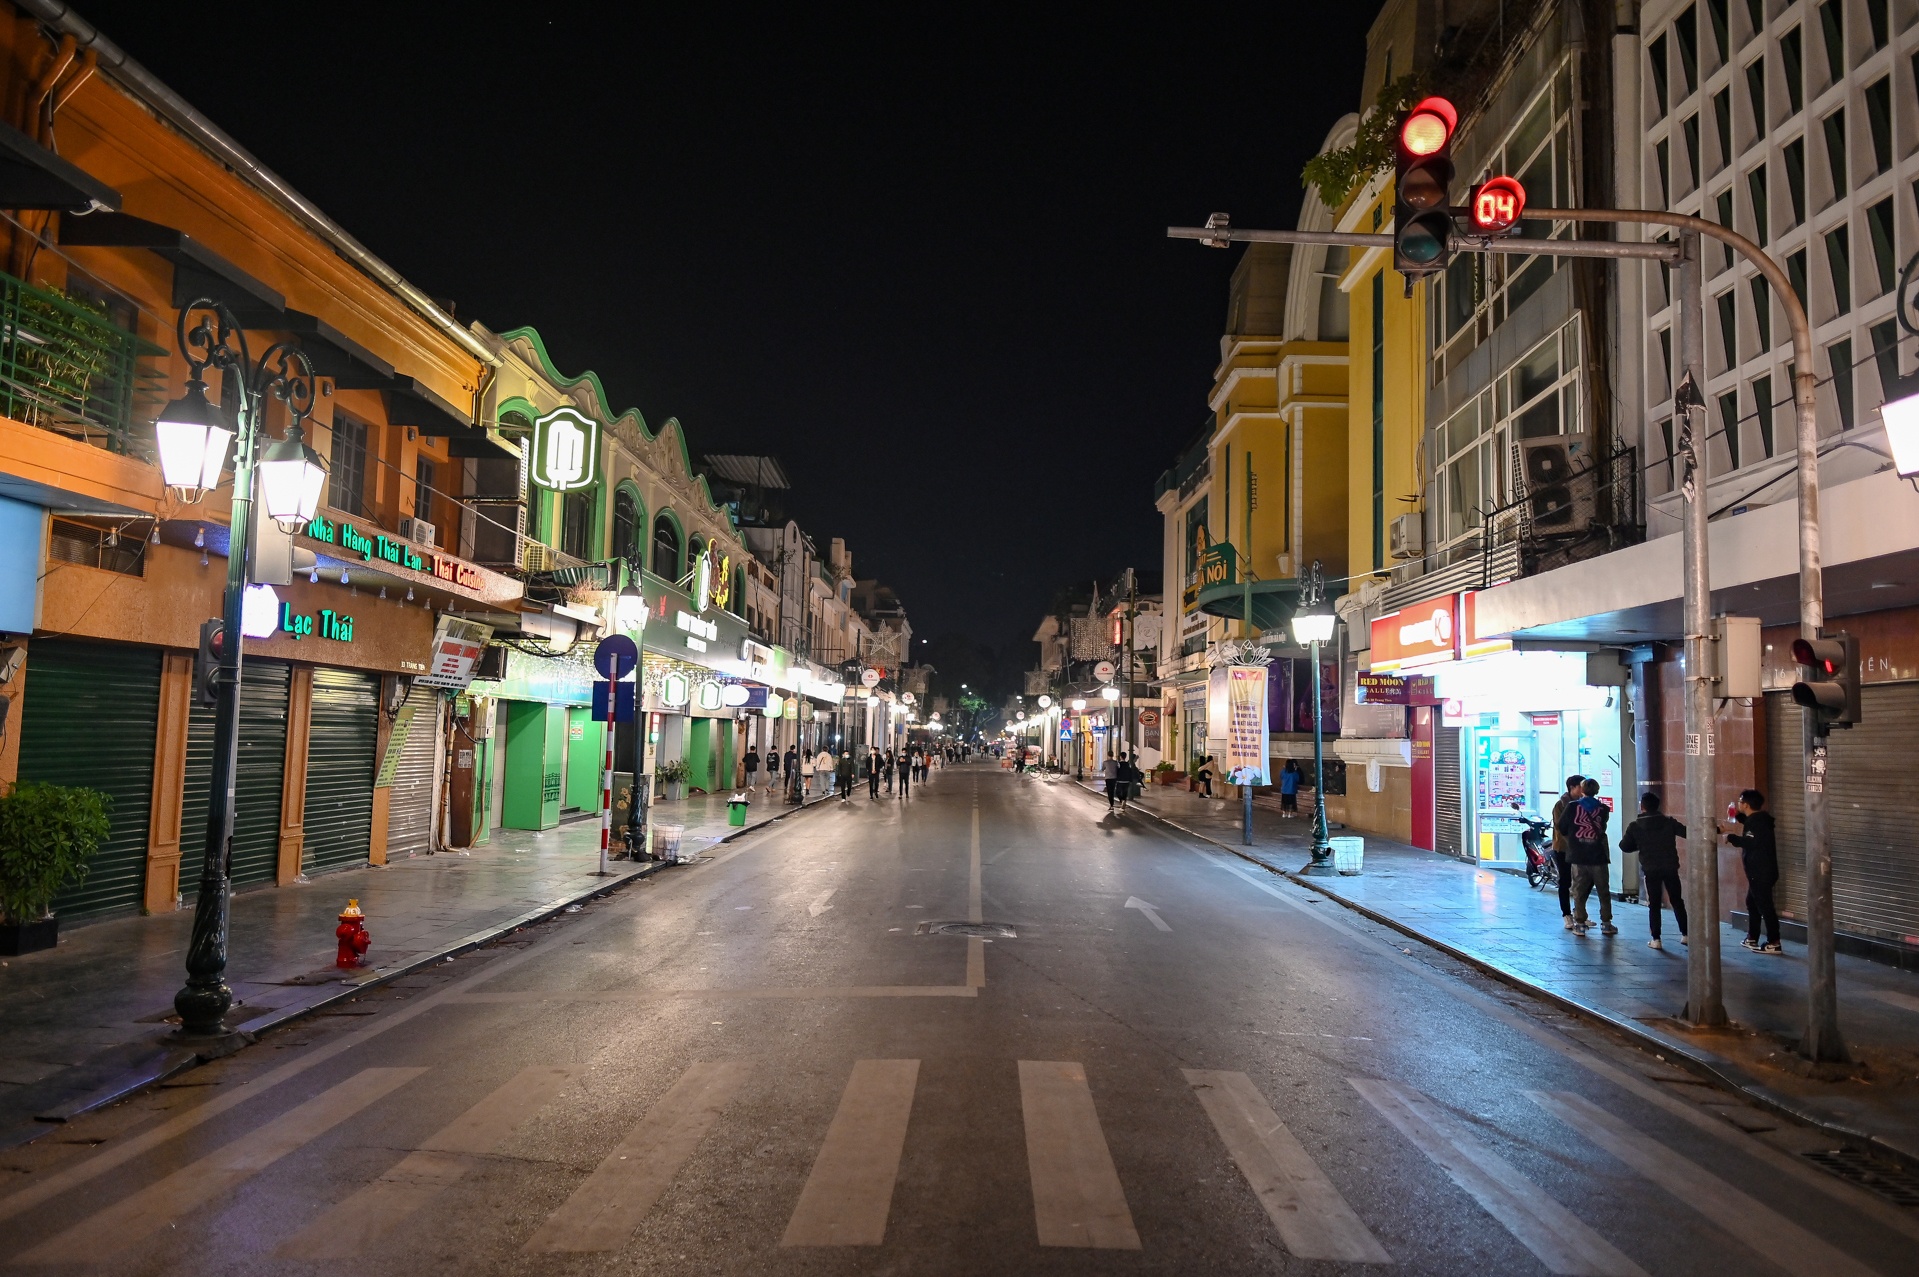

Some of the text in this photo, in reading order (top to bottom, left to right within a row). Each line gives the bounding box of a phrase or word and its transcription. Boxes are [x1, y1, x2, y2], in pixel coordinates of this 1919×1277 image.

[1478, 194, 1514, 222] 04
[308, 515, 334, 543] Nhà
[342, 523, 373, 561] Hàng
[377, 534, 399, 563] Thái
[403, 545, 422, 571] Lan
[456, 563, 486, 590] Cuisine
[1207, 560, 1227, 585] NỘI
[283, 602, 353, 642] Lạc Thái
[1360, 677, 1404, 686] RED MOON
[1774, 668, 1786, 679] 16
